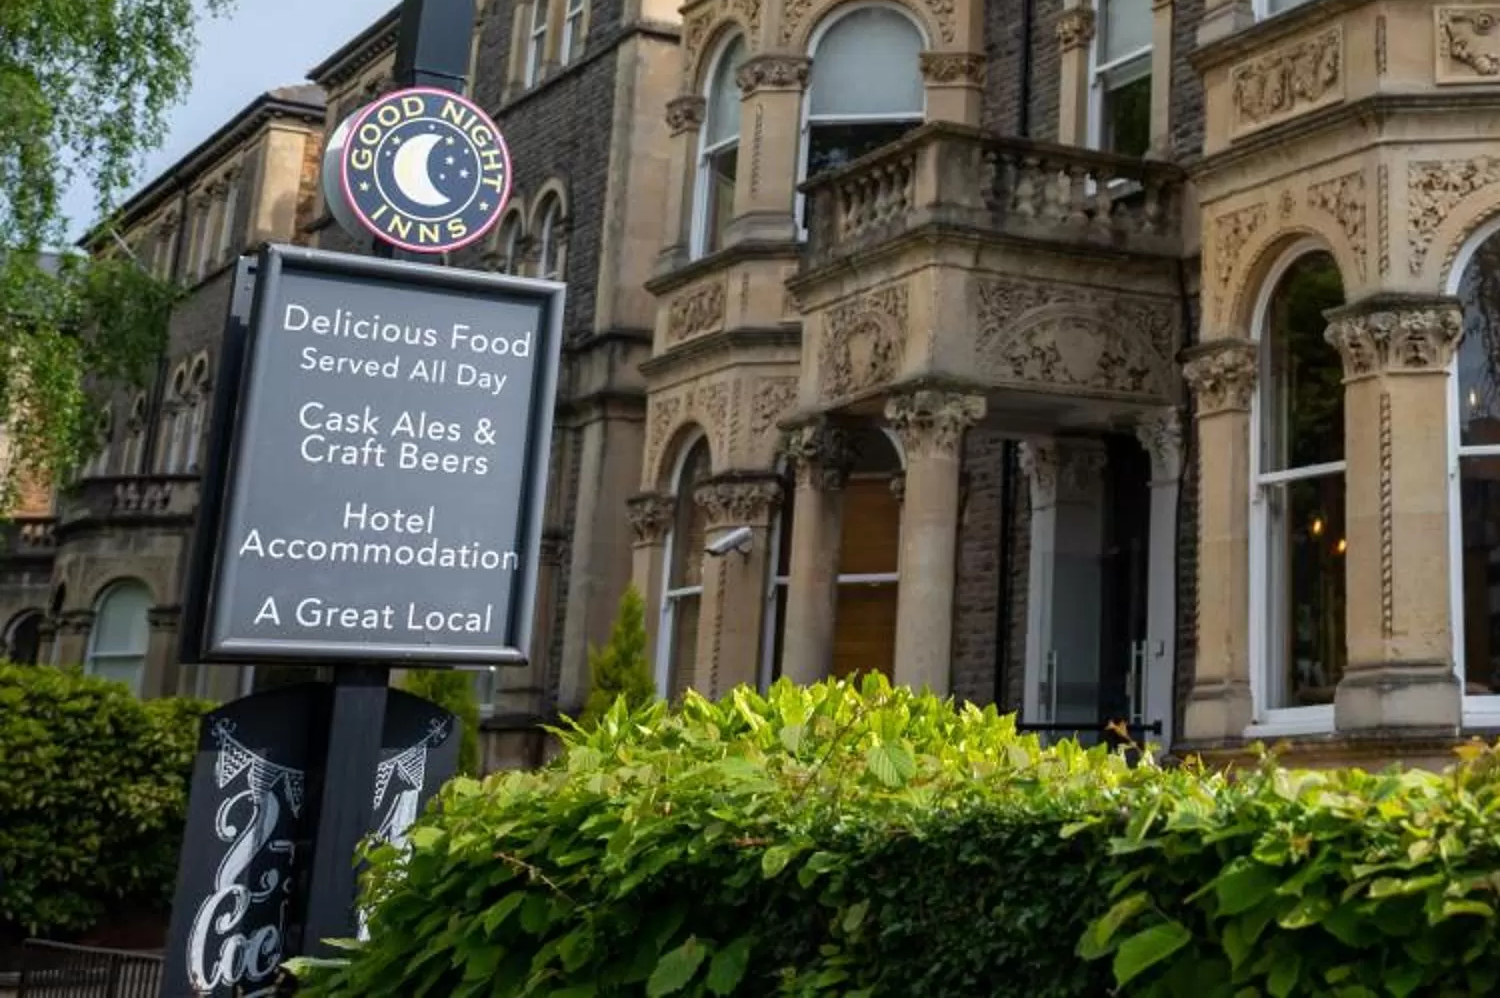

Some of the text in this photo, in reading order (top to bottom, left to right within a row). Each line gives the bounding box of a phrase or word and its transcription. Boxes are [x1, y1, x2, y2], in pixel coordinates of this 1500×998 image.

[351, 96, 503, 193] GOOD NIGHT
[371, 204, 467, 243] INNS
[283, 304, 531, 357] Delicious Food
[301, 347, 507, 395] Served All Day
[299, 402, 497, 445] Cask Ales &
[301, 434, 489, 475] Craft Beers
[343, 502, 435, 534] Hotel
[239, 529, 519, 570] Accommodation
[253, 596, 493, 632] A Great Local
